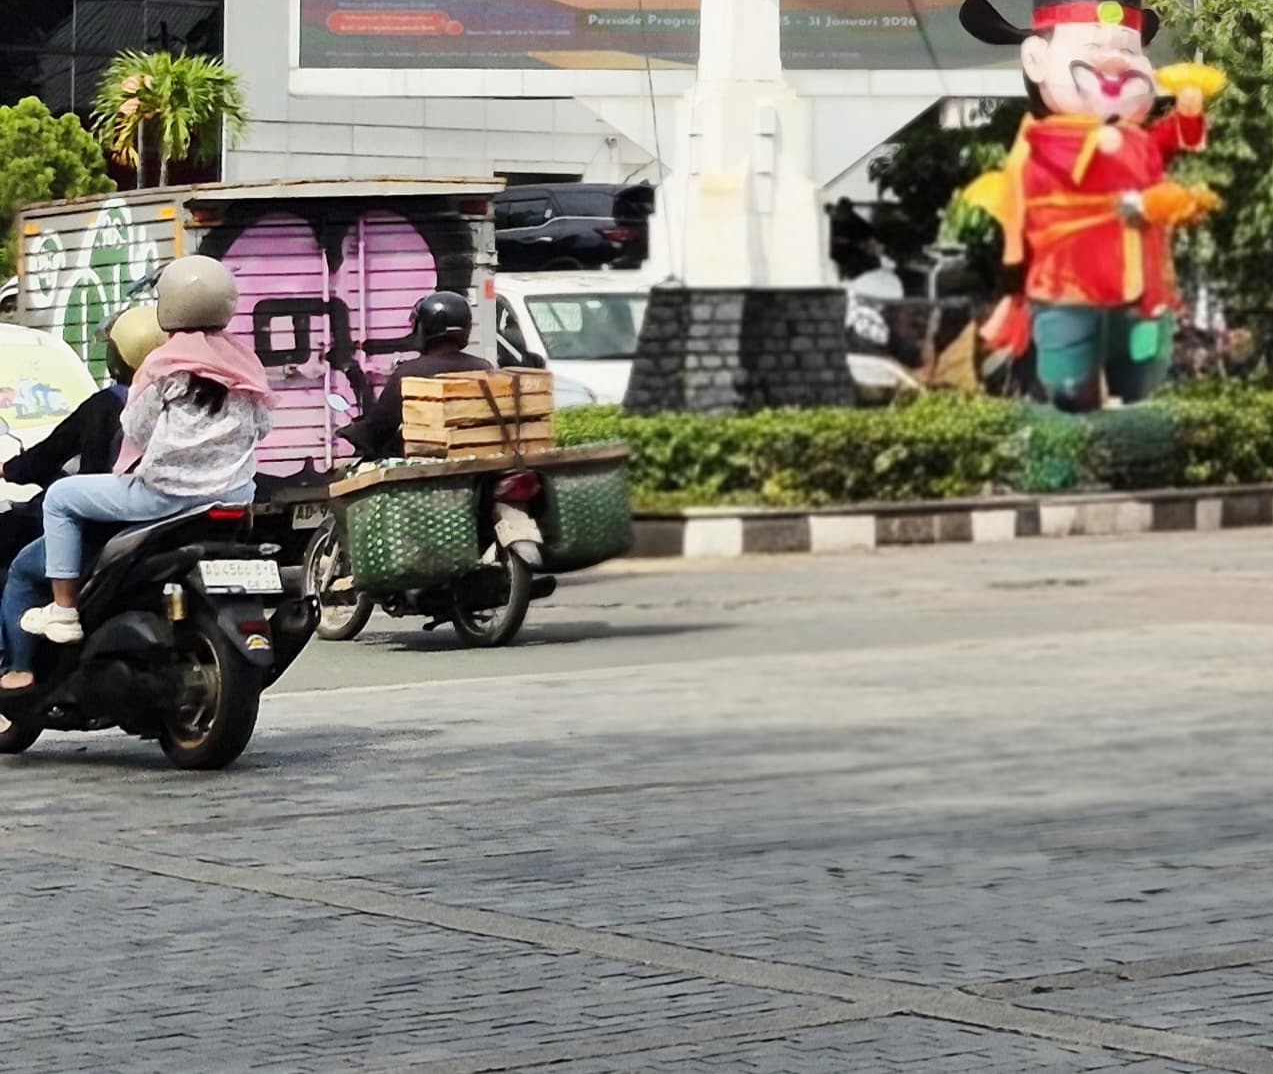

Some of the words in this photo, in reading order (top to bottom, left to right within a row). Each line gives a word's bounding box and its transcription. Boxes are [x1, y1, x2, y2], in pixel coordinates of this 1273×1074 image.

[588, 13, 642, 26] Periode
[647, 13, 700, 28] Progra
[825, 15, 878, 27] Januari
[882, 16, 918, 26] 2026
